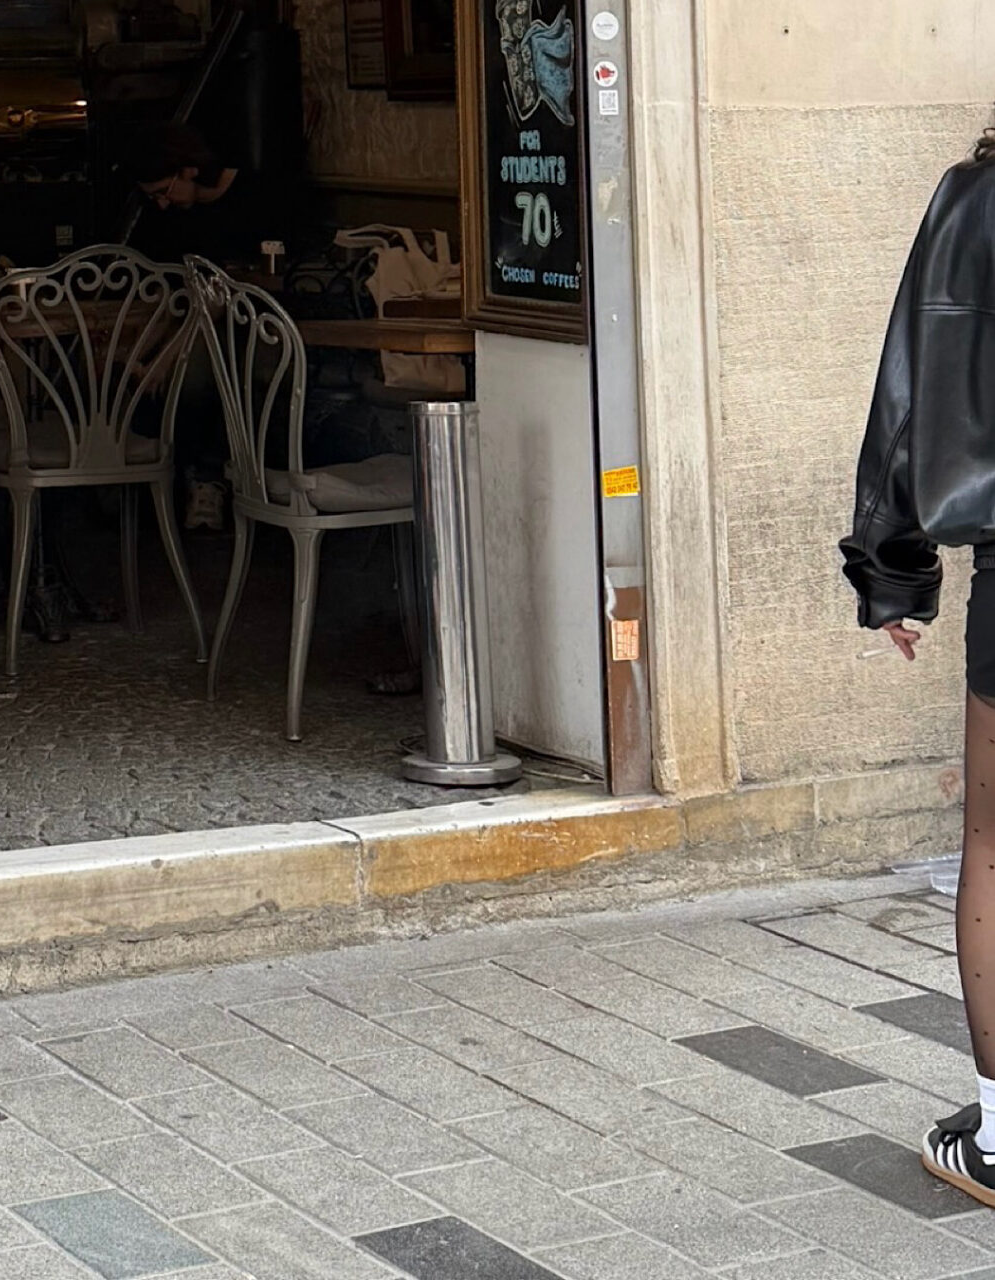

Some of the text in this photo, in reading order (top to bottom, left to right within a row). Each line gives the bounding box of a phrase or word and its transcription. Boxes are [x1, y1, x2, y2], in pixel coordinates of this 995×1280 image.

[519, 129, 541, 151] FOR
[500, 155, 566, 186] STUDENTS
[515, 191, 552, 248] 70
[501, 265, 535, 283] CHOSEN
